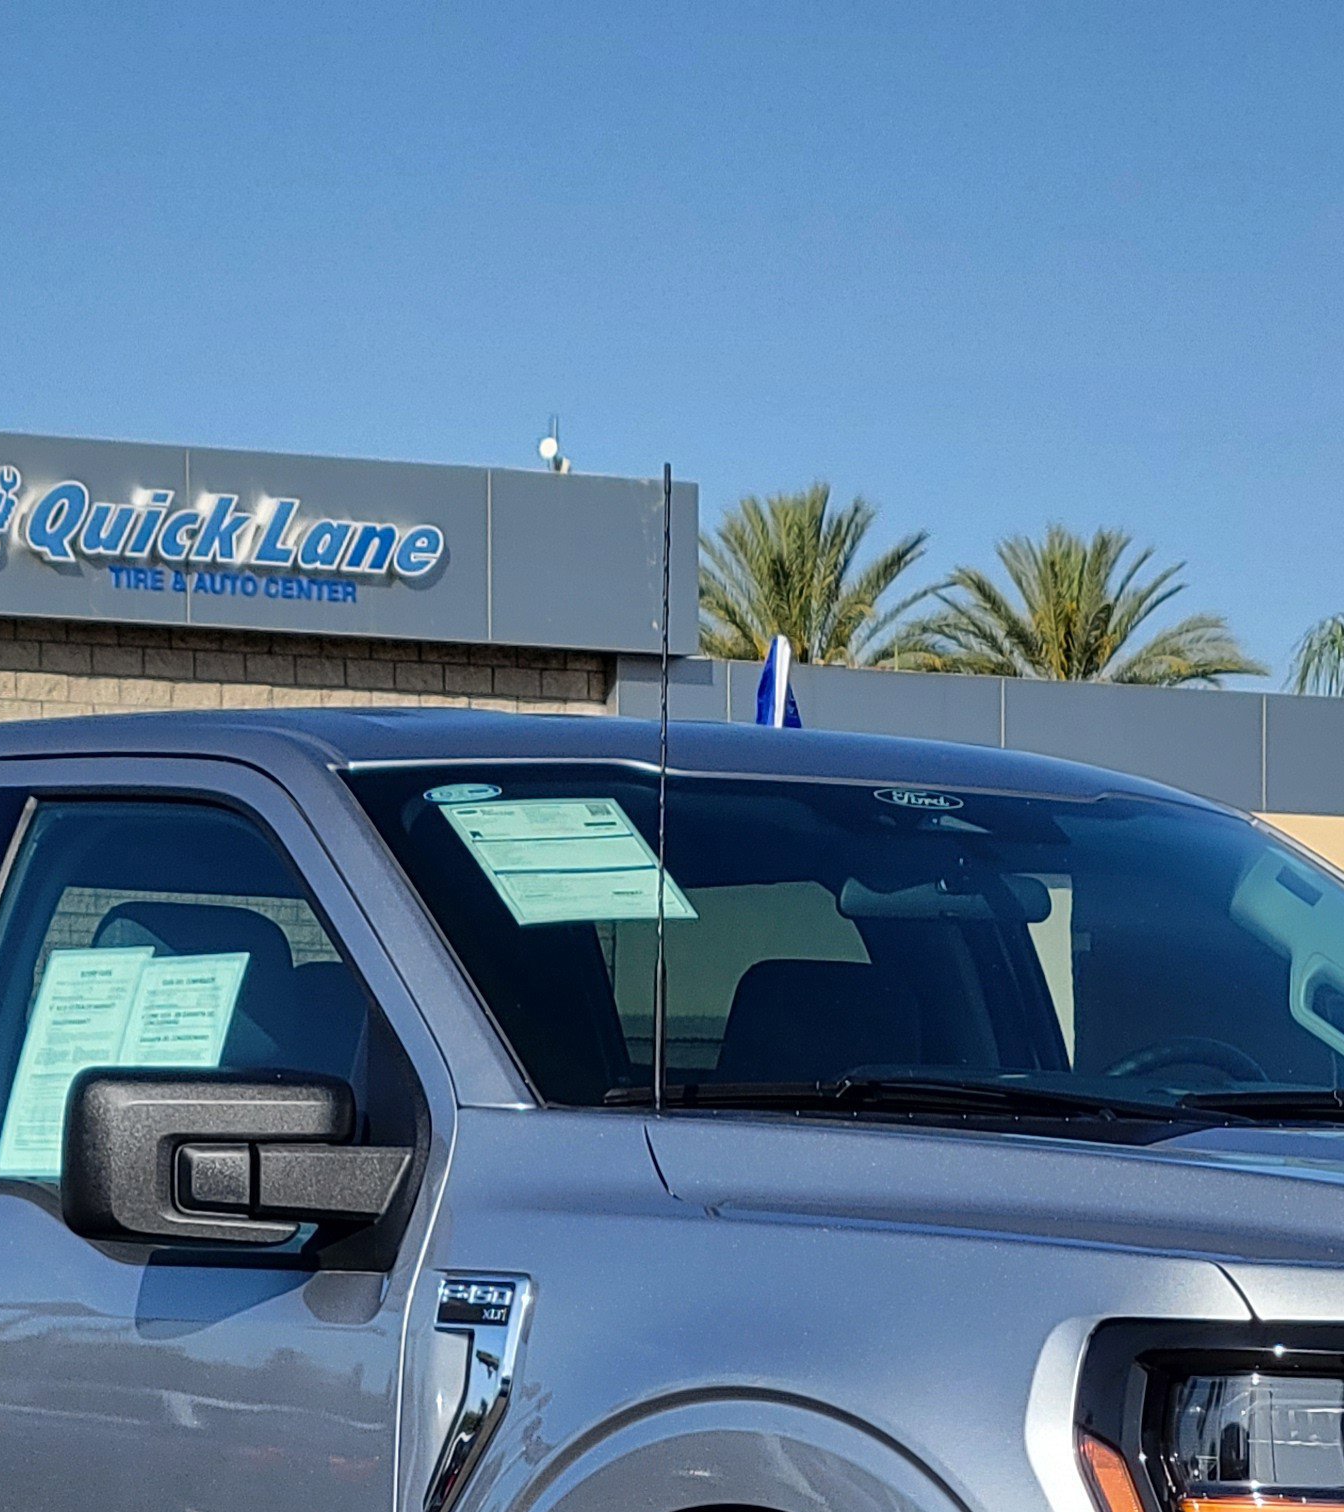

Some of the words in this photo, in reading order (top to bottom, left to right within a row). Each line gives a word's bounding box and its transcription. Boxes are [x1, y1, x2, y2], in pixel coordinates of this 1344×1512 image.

[25, 480, 250, 564] Quick
[251, 498, 446, 578] Lane
[108, 565, 164, 592] TIRE
[172, 569, 186, 593] &
[193, 573, 257, 598] AUTO
[264, 576, 357, 603] CENTER
[891, 789, 950, 807] Ford
